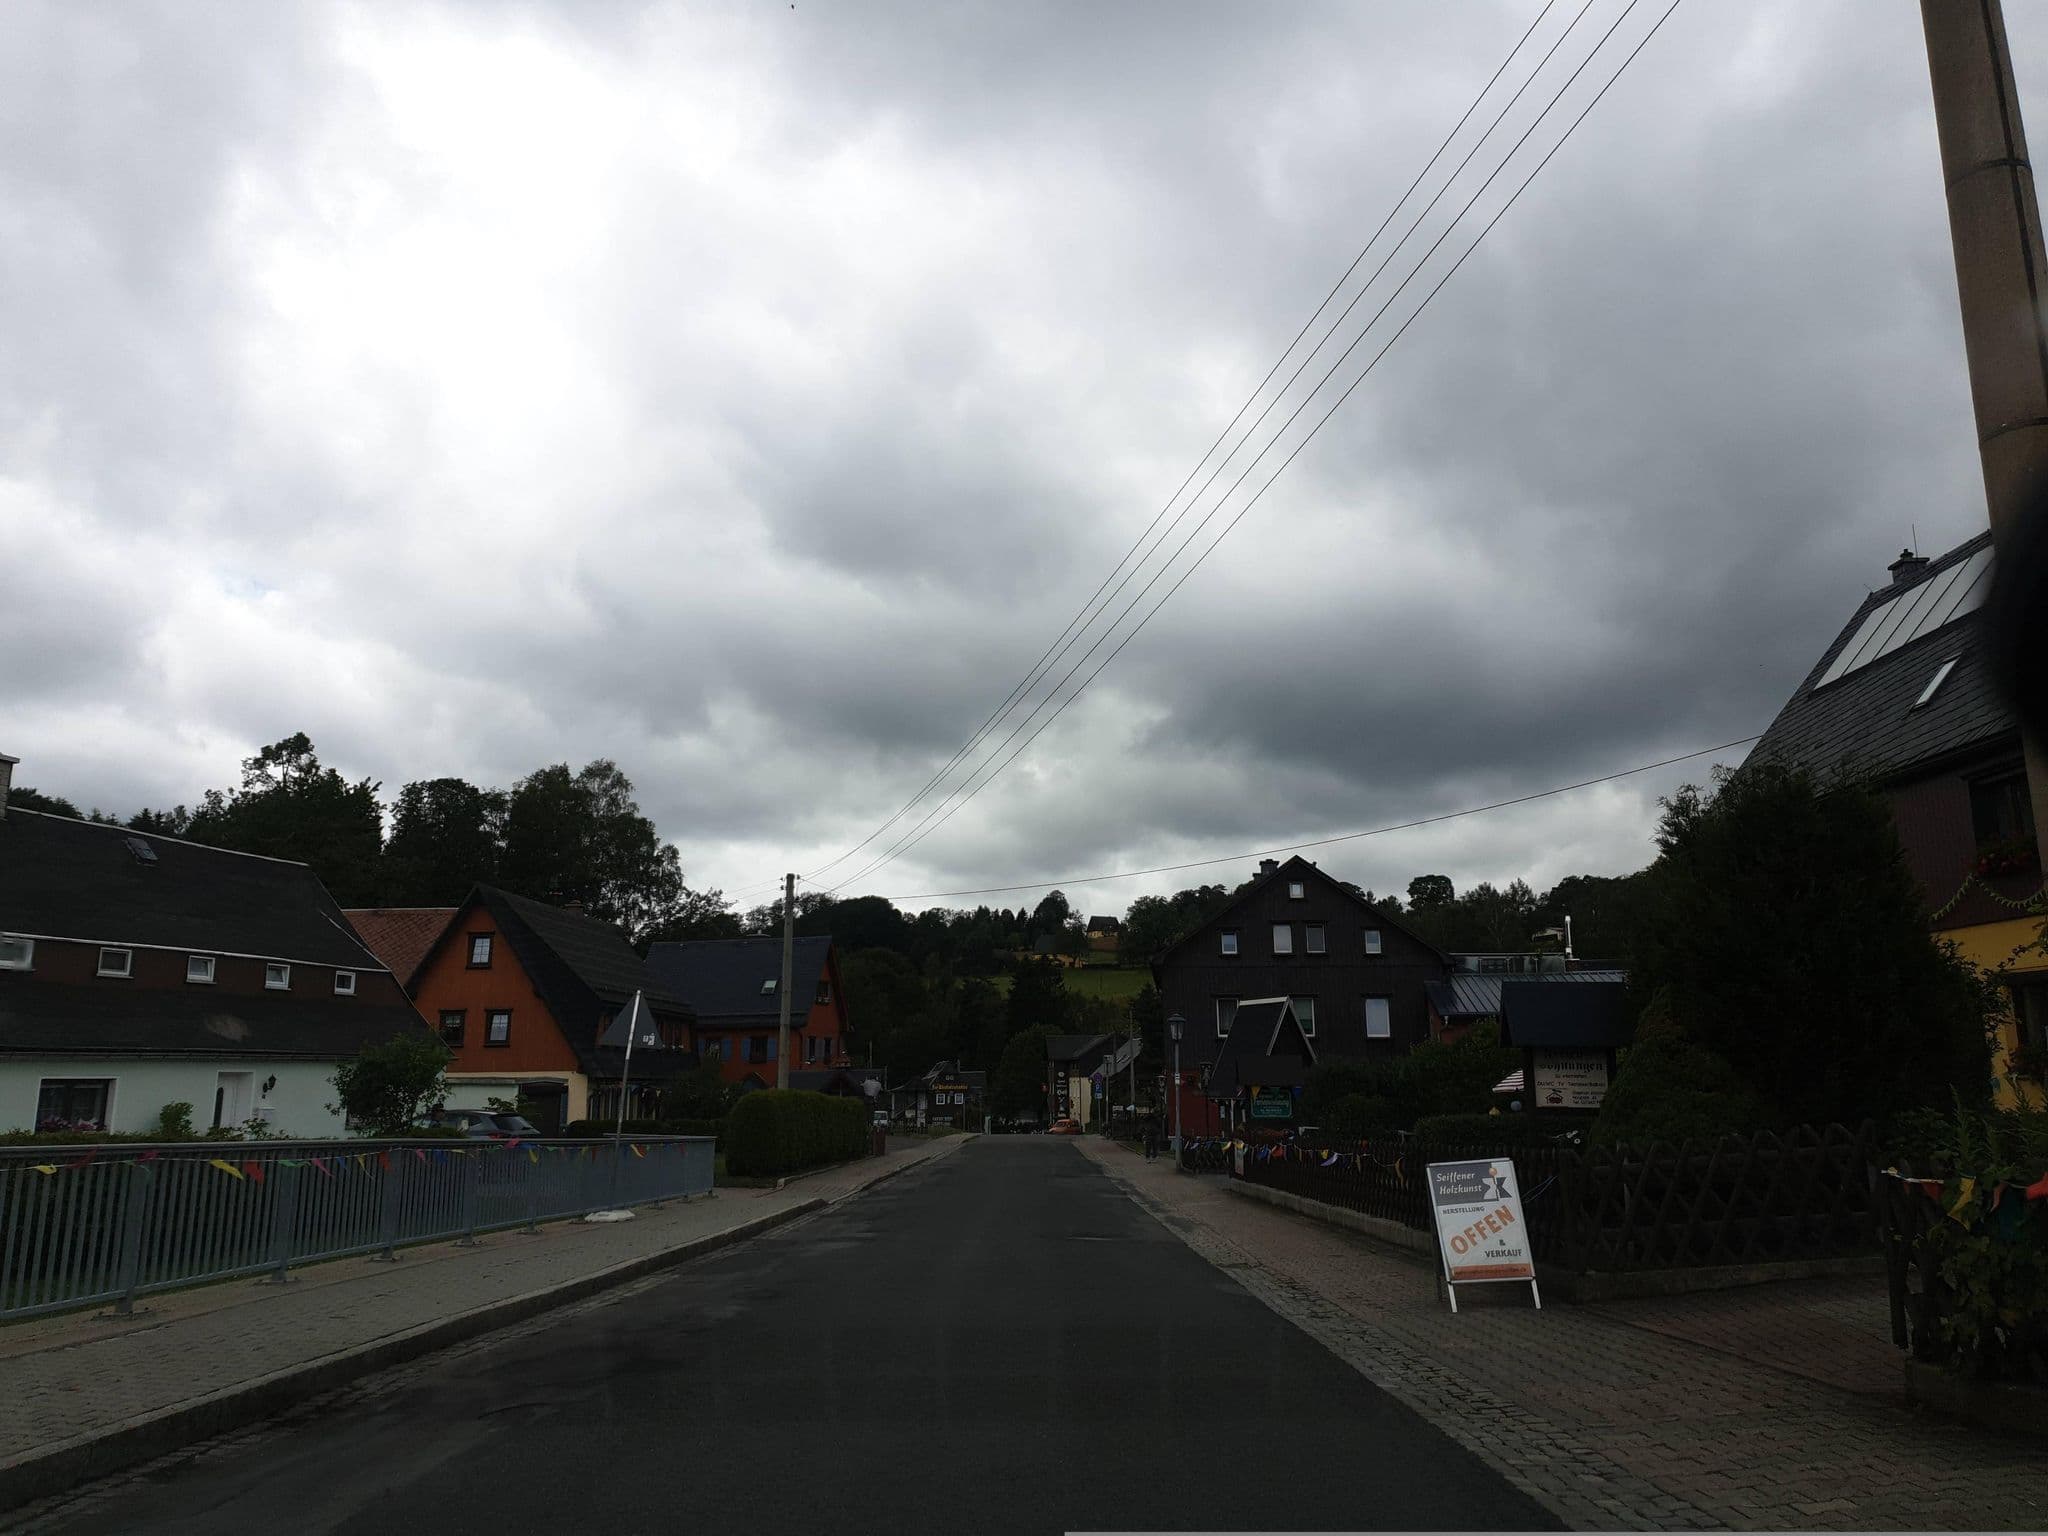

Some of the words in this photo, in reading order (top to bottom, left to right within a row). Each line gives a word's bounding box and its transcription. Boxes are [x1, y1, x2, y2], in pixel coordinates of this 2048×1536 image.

[1436, 1172, 1475, 1183] Seiffener
[1440, 1184, 1482, 1195] Holzkunst
[1442, 1206, 1485, 1215] HERSTELLUNG
[1450, 1205, 1516, 1255] OFFEN
[1484, 1249, 1522, 1258] VERKAUF
